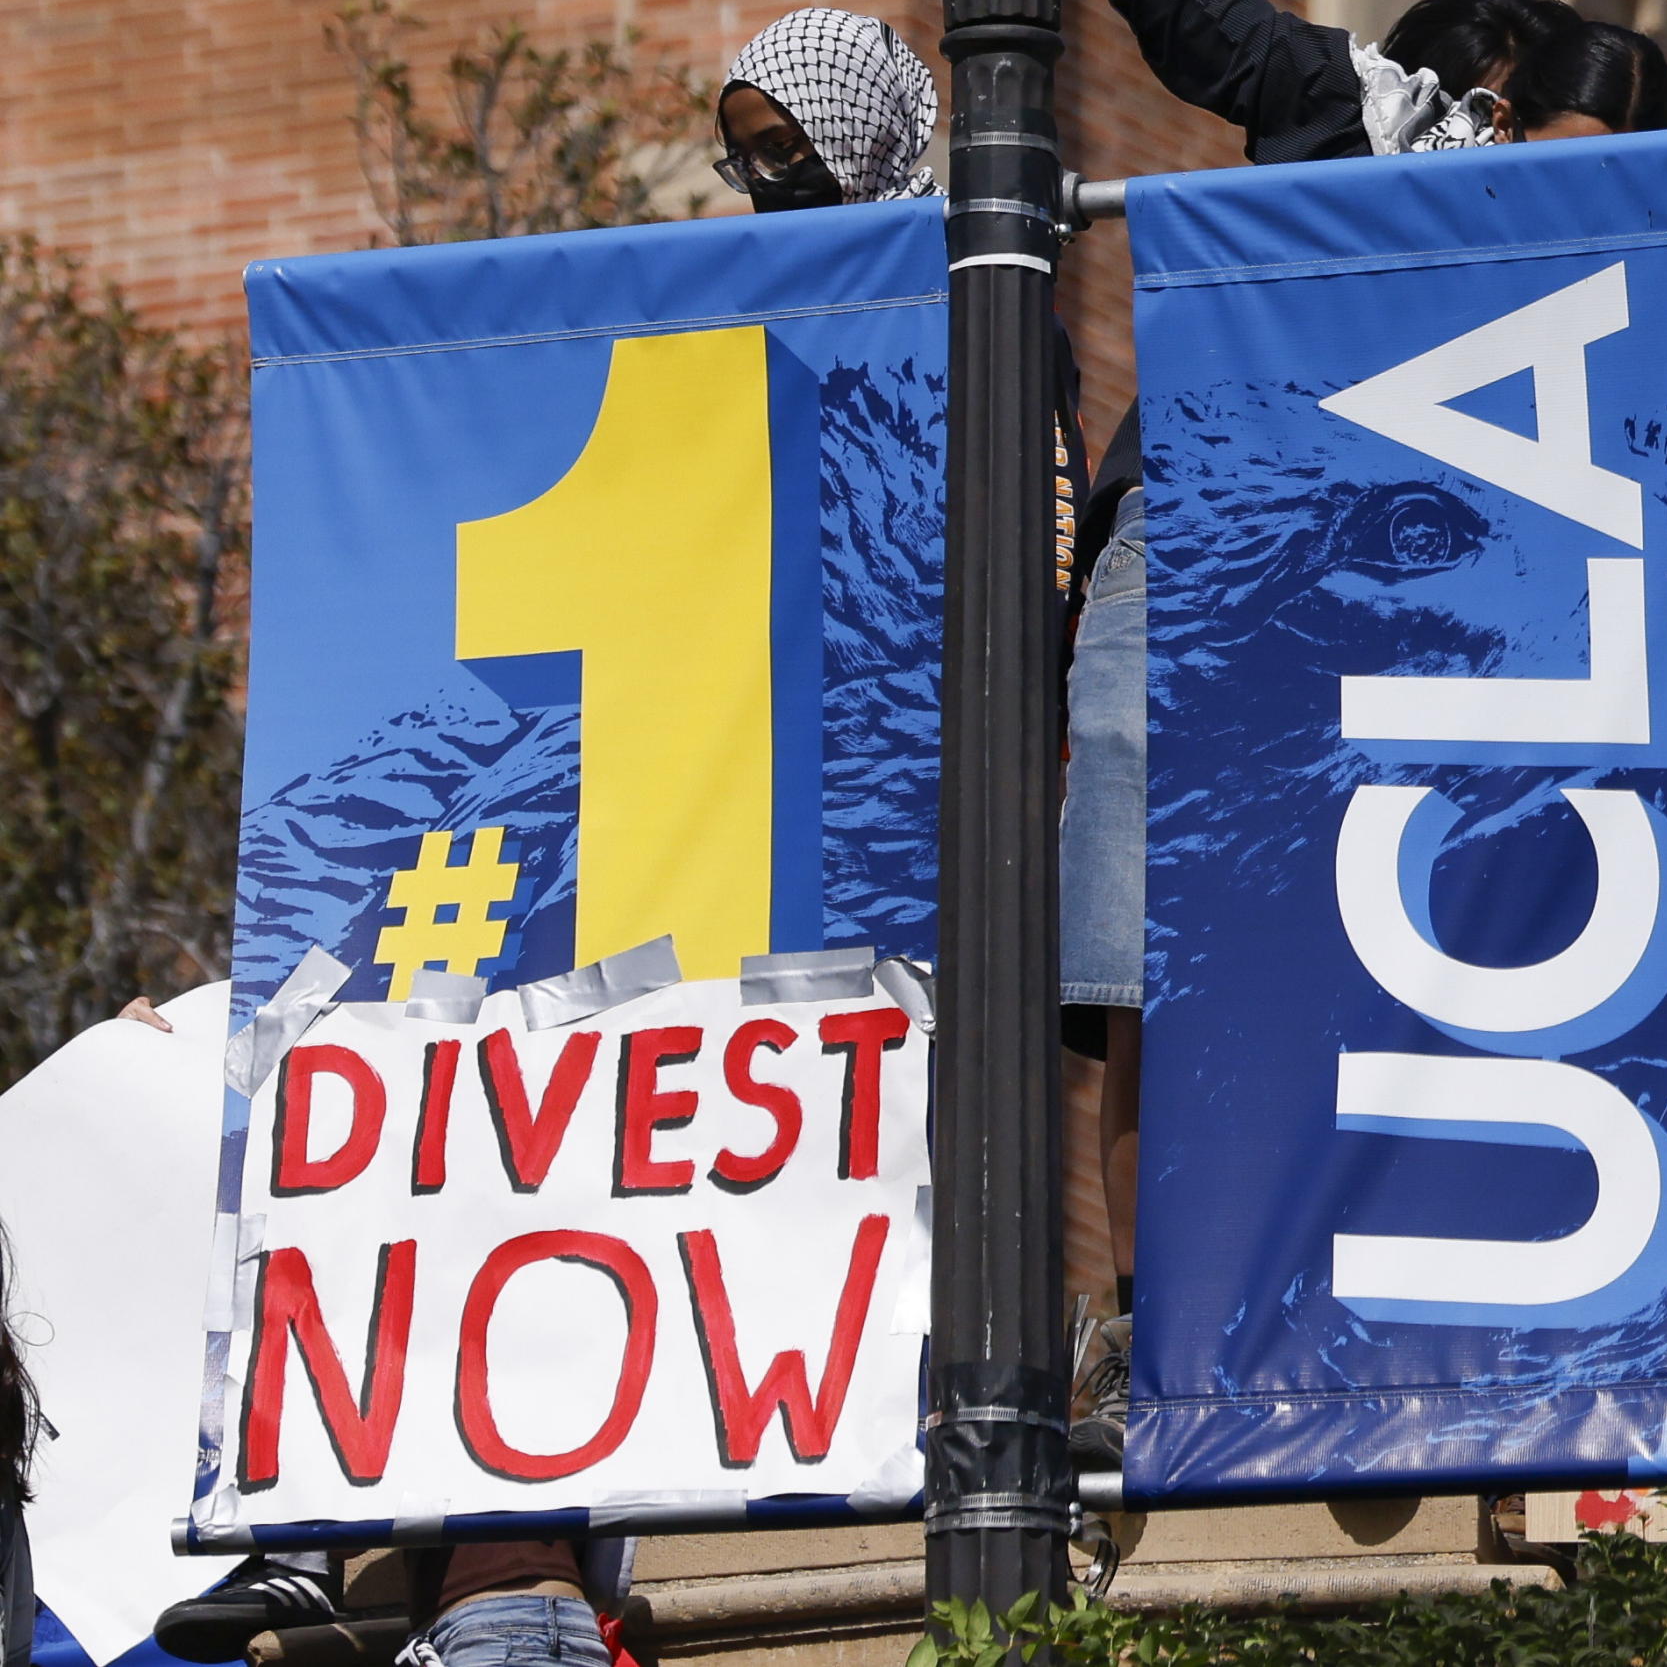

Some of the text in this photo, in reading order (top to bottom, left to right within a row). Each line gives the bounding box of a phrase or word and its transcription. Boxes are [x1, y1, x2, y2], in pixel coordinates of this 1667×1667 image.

[1319, 261, 1661, 1305] UCLA
[271, 1007, 910, 1198] DIVEST
[237, 1213, 890, 1494] NOW
